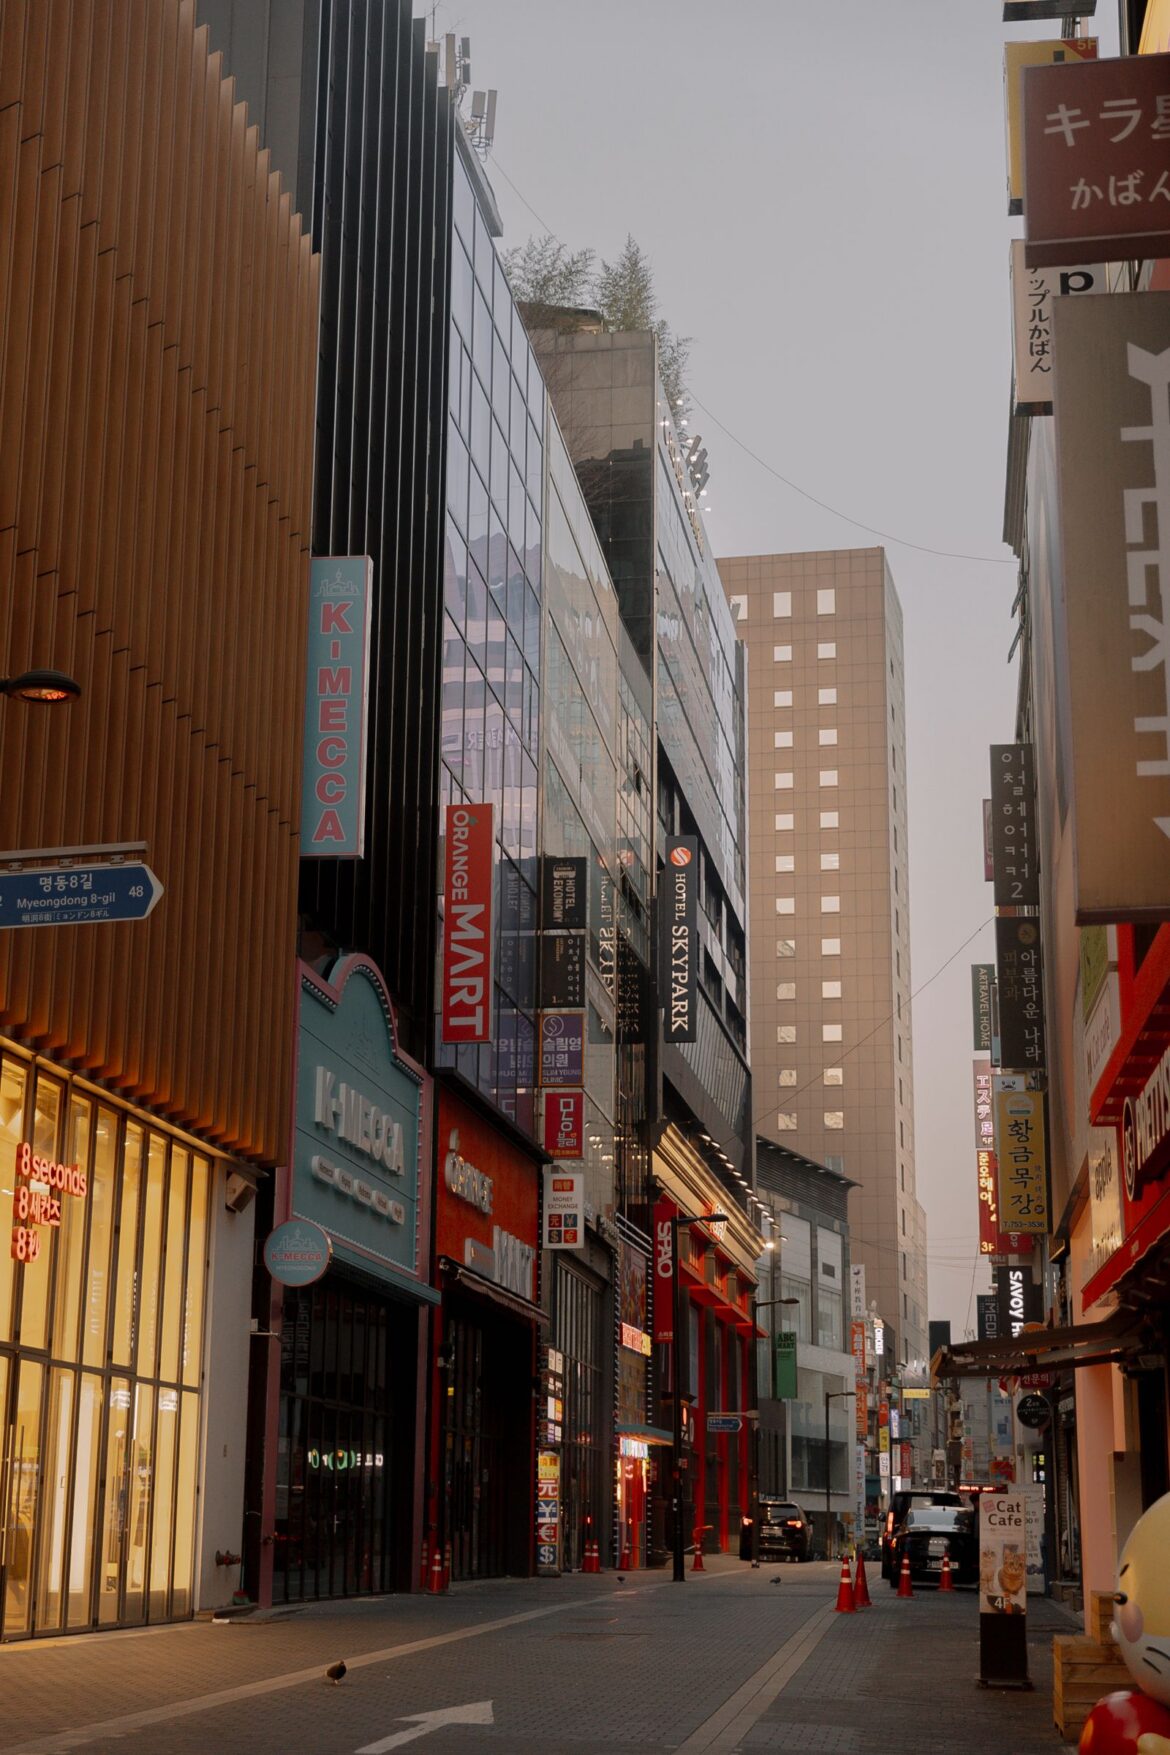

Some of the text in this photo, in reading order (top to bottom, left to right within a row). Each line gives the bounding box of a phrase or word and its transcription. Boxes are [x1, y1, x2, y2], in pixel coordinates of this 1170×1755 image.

[39, 873, 92, 893] 명동8길
[128, 885, 144, 898] 48
[1011, 882, 1023, 898] 2
[17, 891, 116, 910] Myeongdong 8-gil
[553, 879, 564, 923] EKONOMY
[566, 879, 576, 909] HOTEL
[450, 810, 485, 1036] ORANGE MART
[671, 873, 689, 1032] HOTEL SKYPARK
[1020, 949, 1043, 1062] 아름다운 나라
[543, 1037, 582, 1052] 슬림영
[543, 1053, 568, 1067] 의원
[1008, 1119, 1034, 1215] 황금목장
[1008, 1270, 1025, 1318] SAVOY
[778, 1333, 795, 1342] ABC
[538, 1479, 558, 1496] 元
[997, 1500, 1021, 1513] Cat
[988, 1513, 1022, 1527] Cafe
